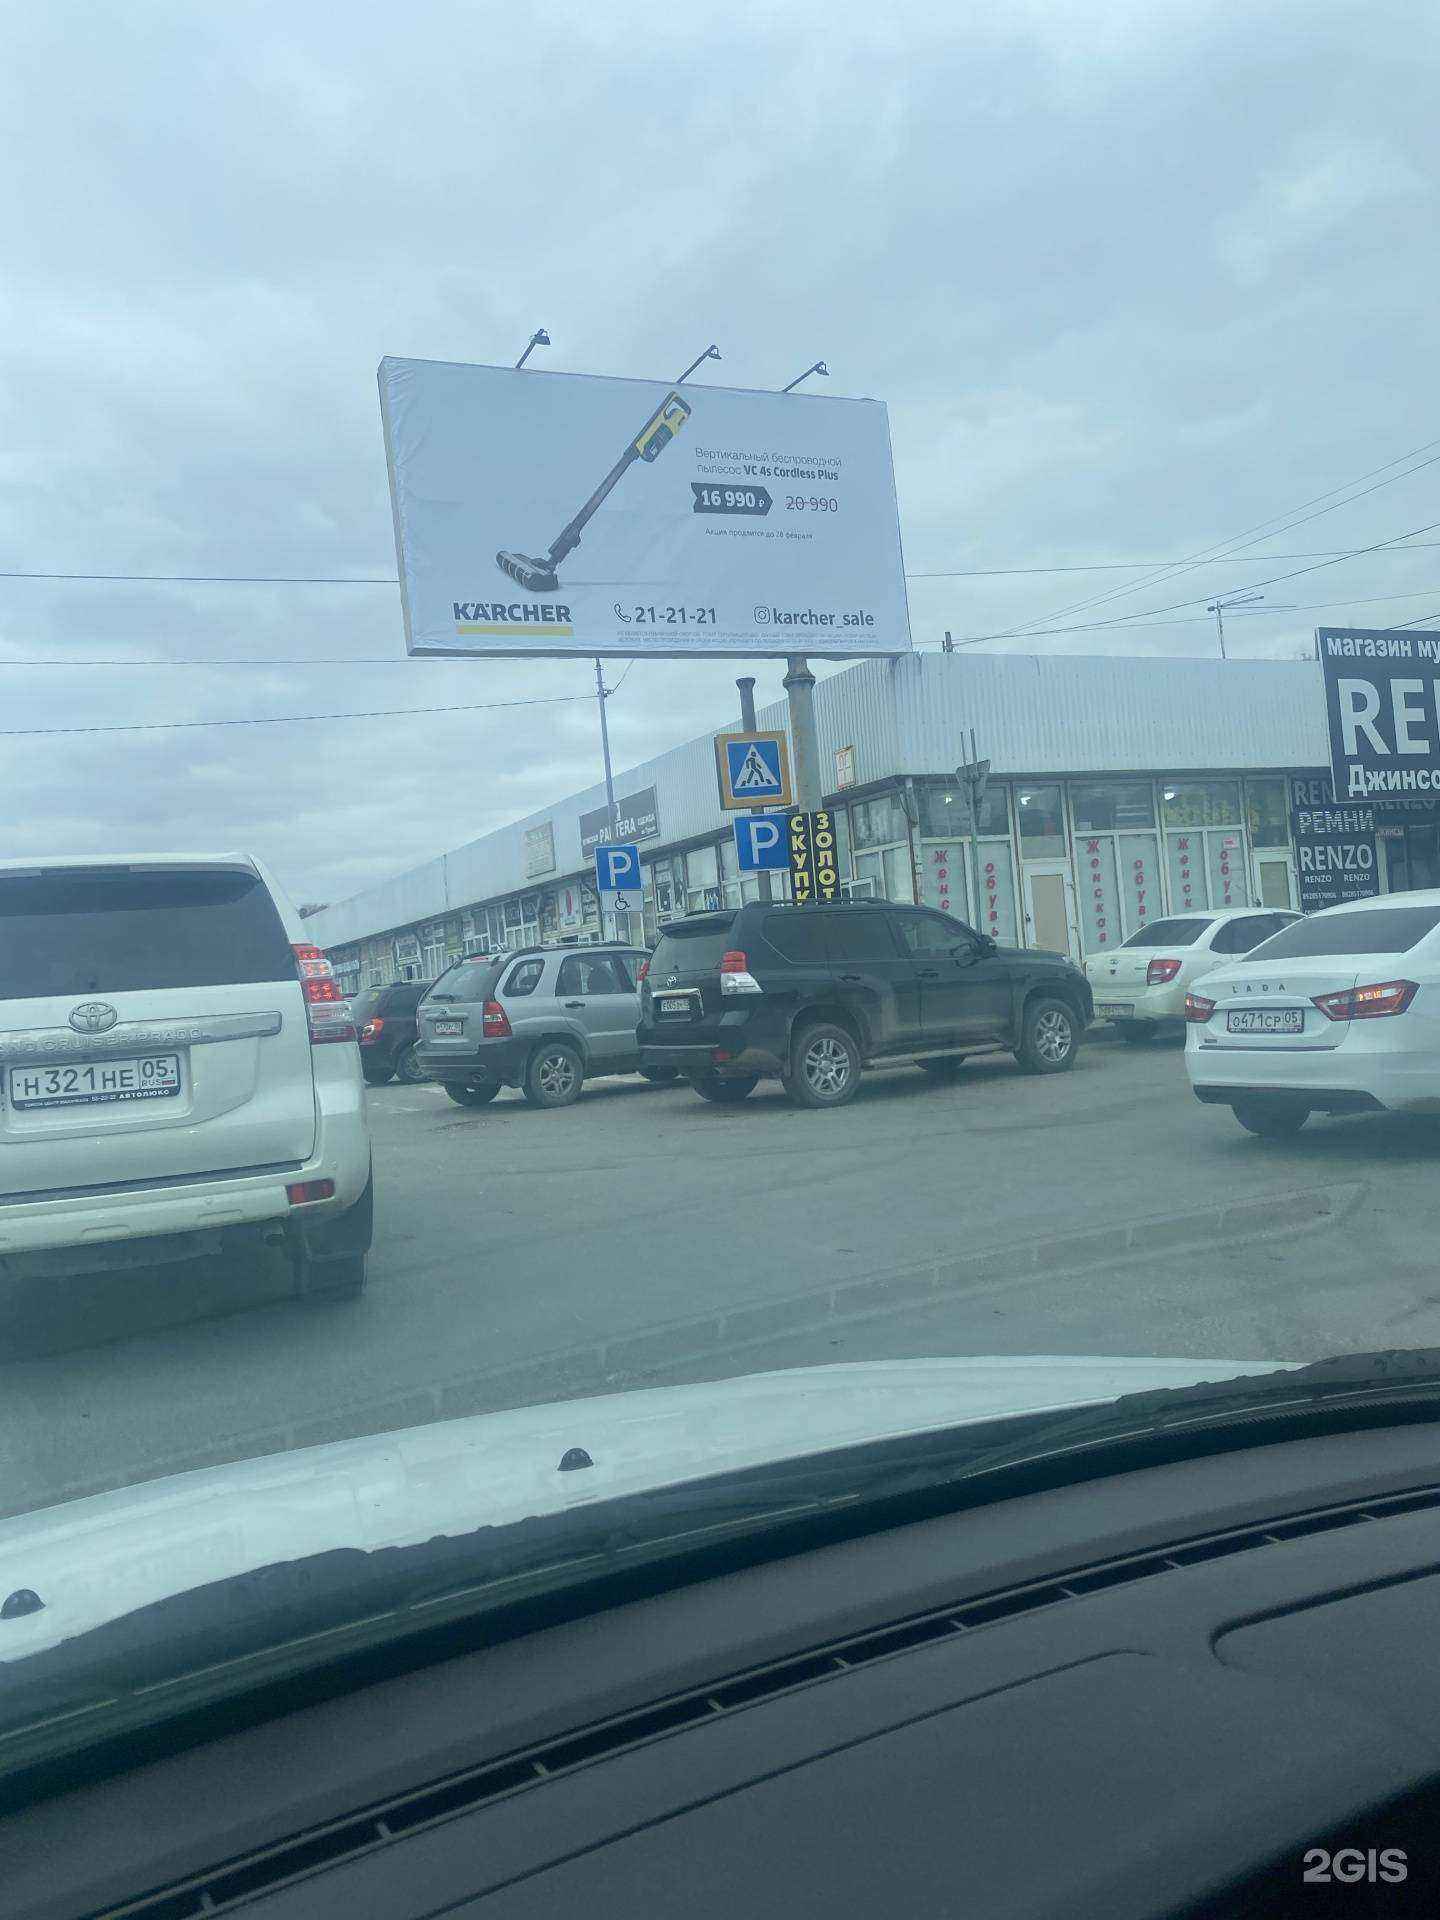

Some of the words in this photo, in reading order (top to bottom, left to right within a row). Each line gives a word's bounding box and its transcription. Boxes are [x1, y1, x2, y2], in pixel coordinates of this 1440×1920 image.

[695, 447, 770, 462] Вертикальный
[771, 452, 842, 468] беспроводной
[697, 464, 741, 475] пылесос
[743, 465, 757, 476] VC
[760, 465, 772, 477] 4s
[774, 467, 816, 479] Cordless
[817, 469, 839, 481] Plus
[701, 490, 722, 506] 16
[724, 491, 756, 508] 990
[785, 495, 805, 512] 20
[809, 497, 838, 513] 990
[453, 602, 572, 623] KÄRCHER
[635, 605, 717, 624] 21-21-21
[773, 607, 875, 629] karcher_sale
[1326, 637, 1412, 658] магазин
[1337, 678, 1440, 756] RE
[1298, 809, 1375, 834] РЕМНИ
[1300, 844, 1373, 872] RENZO
[1304, 874, 1332, 883] RENZO
[1343, 873, 1370, 883] RENZO
[1232, 983, 1286, 994] LADA
[1284, 1011, 1298, 1023] 05
[142, 1059, 168, 1079] 05
